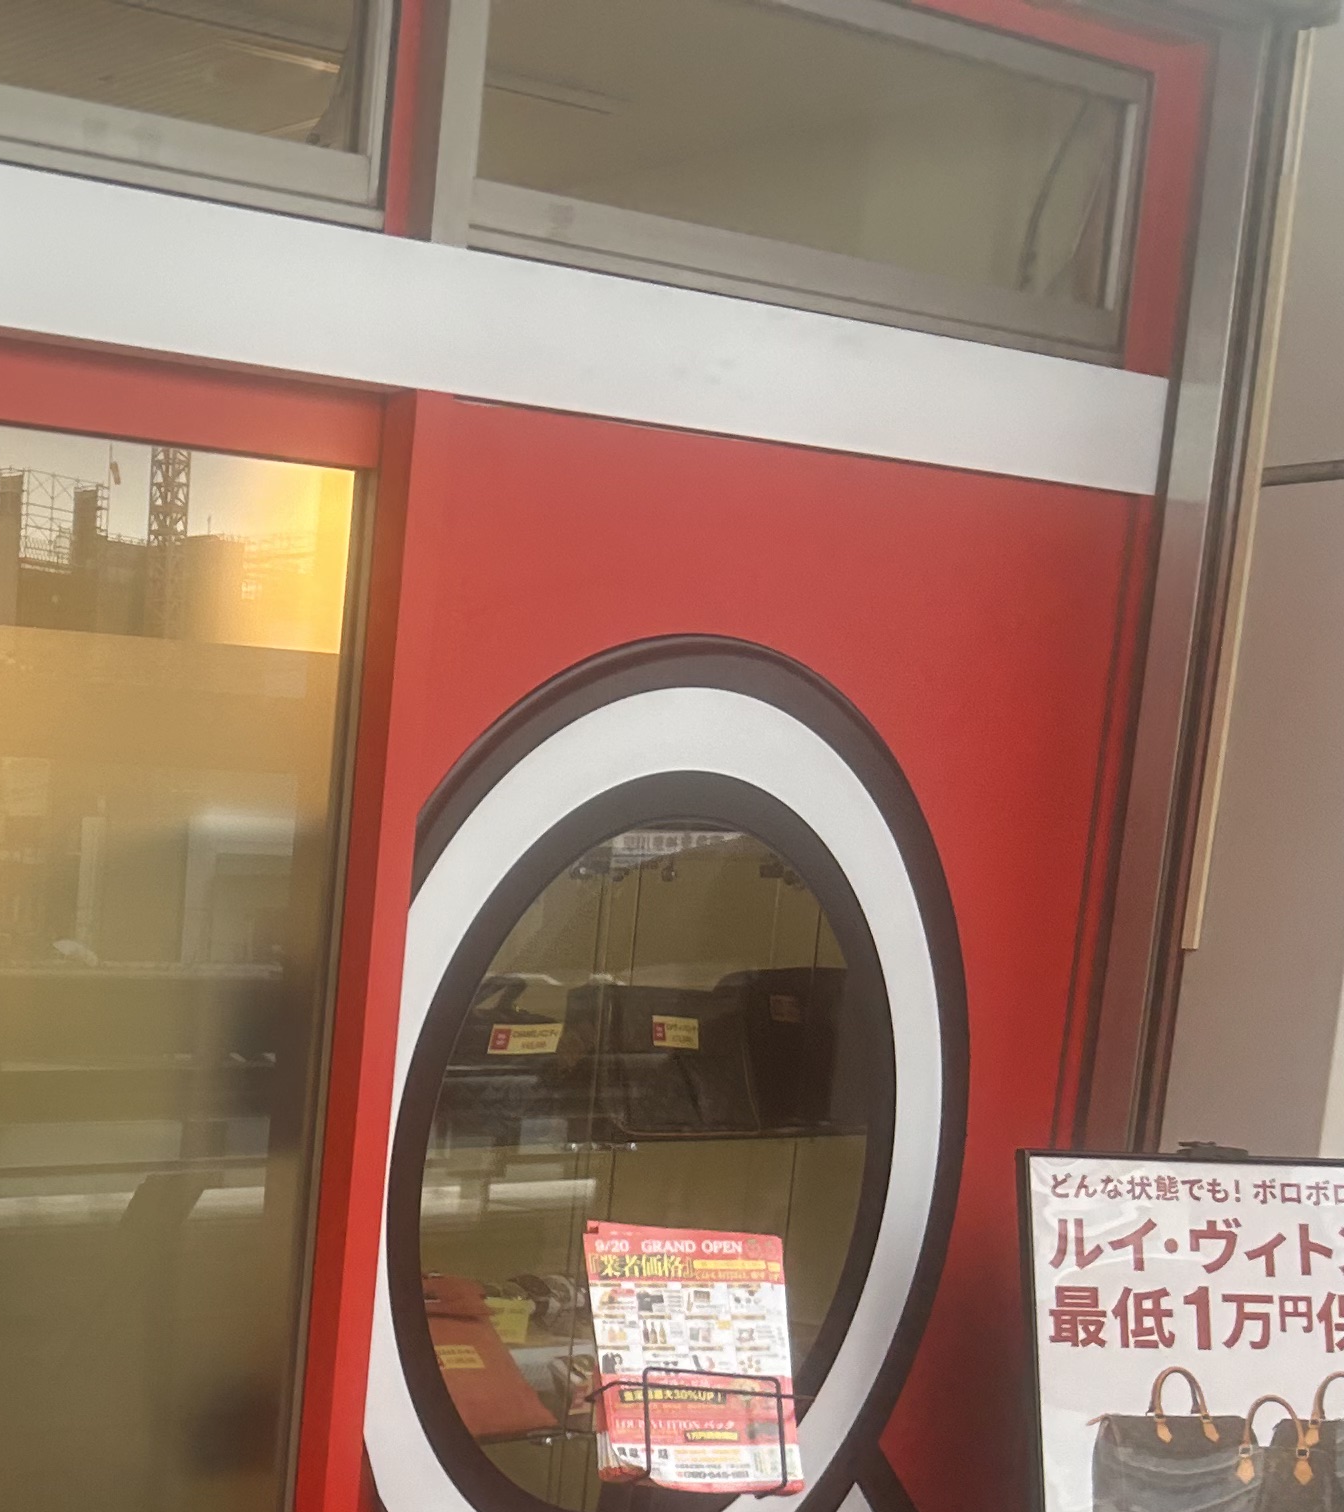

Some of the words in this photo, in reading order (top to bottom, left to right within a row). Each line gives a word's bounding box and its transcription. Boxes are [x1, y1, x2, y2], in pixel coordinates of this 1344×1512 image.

[641, 1239, 697, 1253] GRAND
[701, 1239, 743, 1254] OPEN
[1049, 1218, 1344, 1278] ルイ・ヴィト
